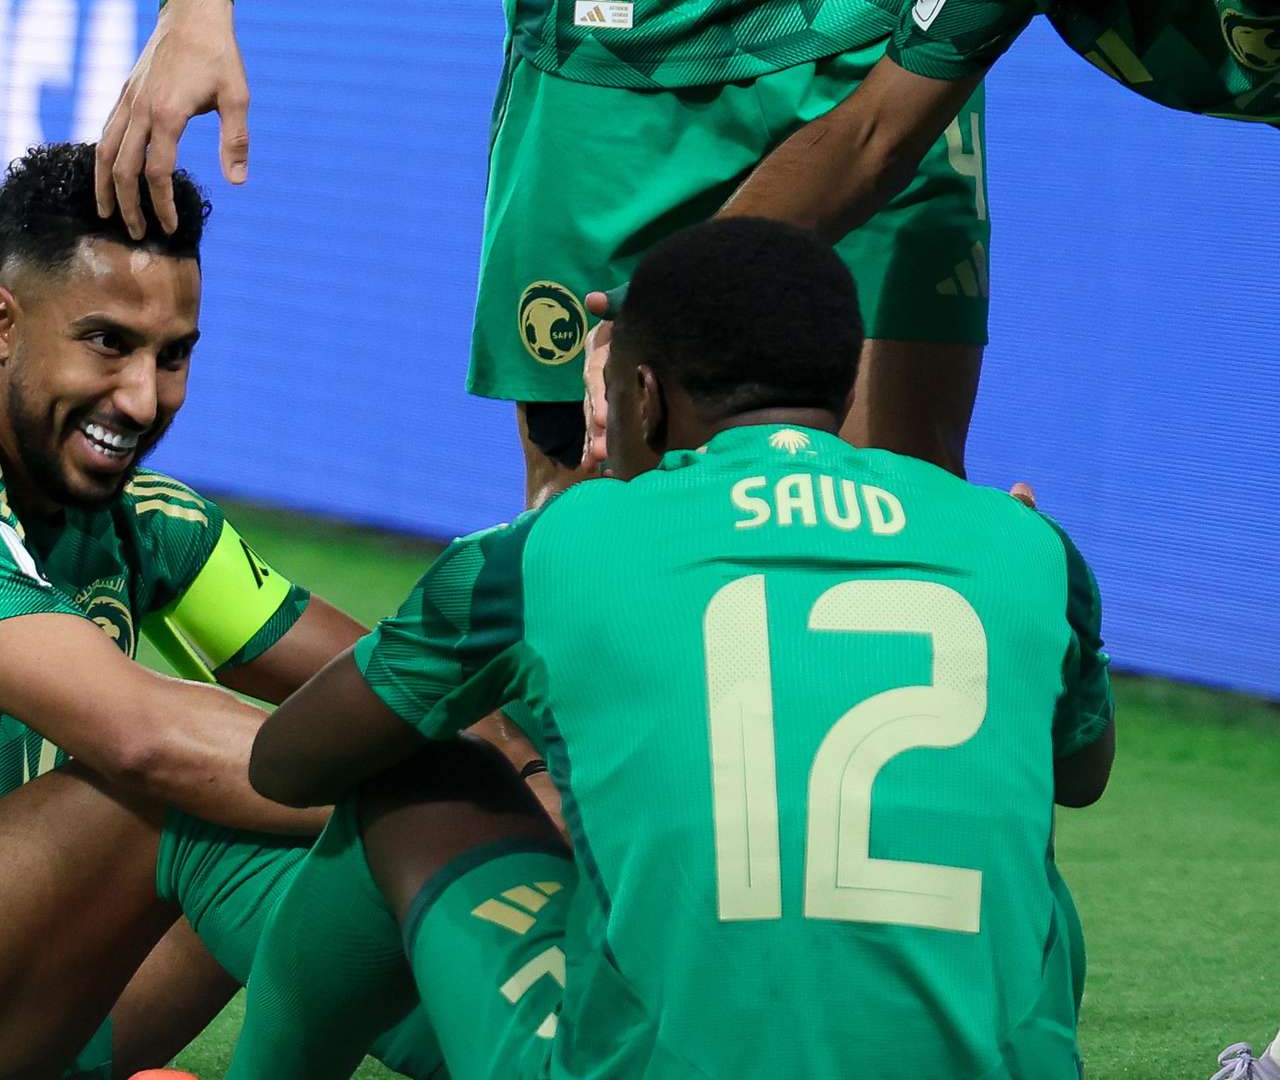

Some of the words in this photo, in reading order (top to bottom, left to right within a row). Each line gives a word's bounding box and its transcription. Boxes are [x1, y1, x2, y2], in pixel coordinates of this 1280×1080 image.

[943, 111, 987, 221] 4
[729, 473, 907, 537] SAUD
[702, 573, 989, 934] 12
